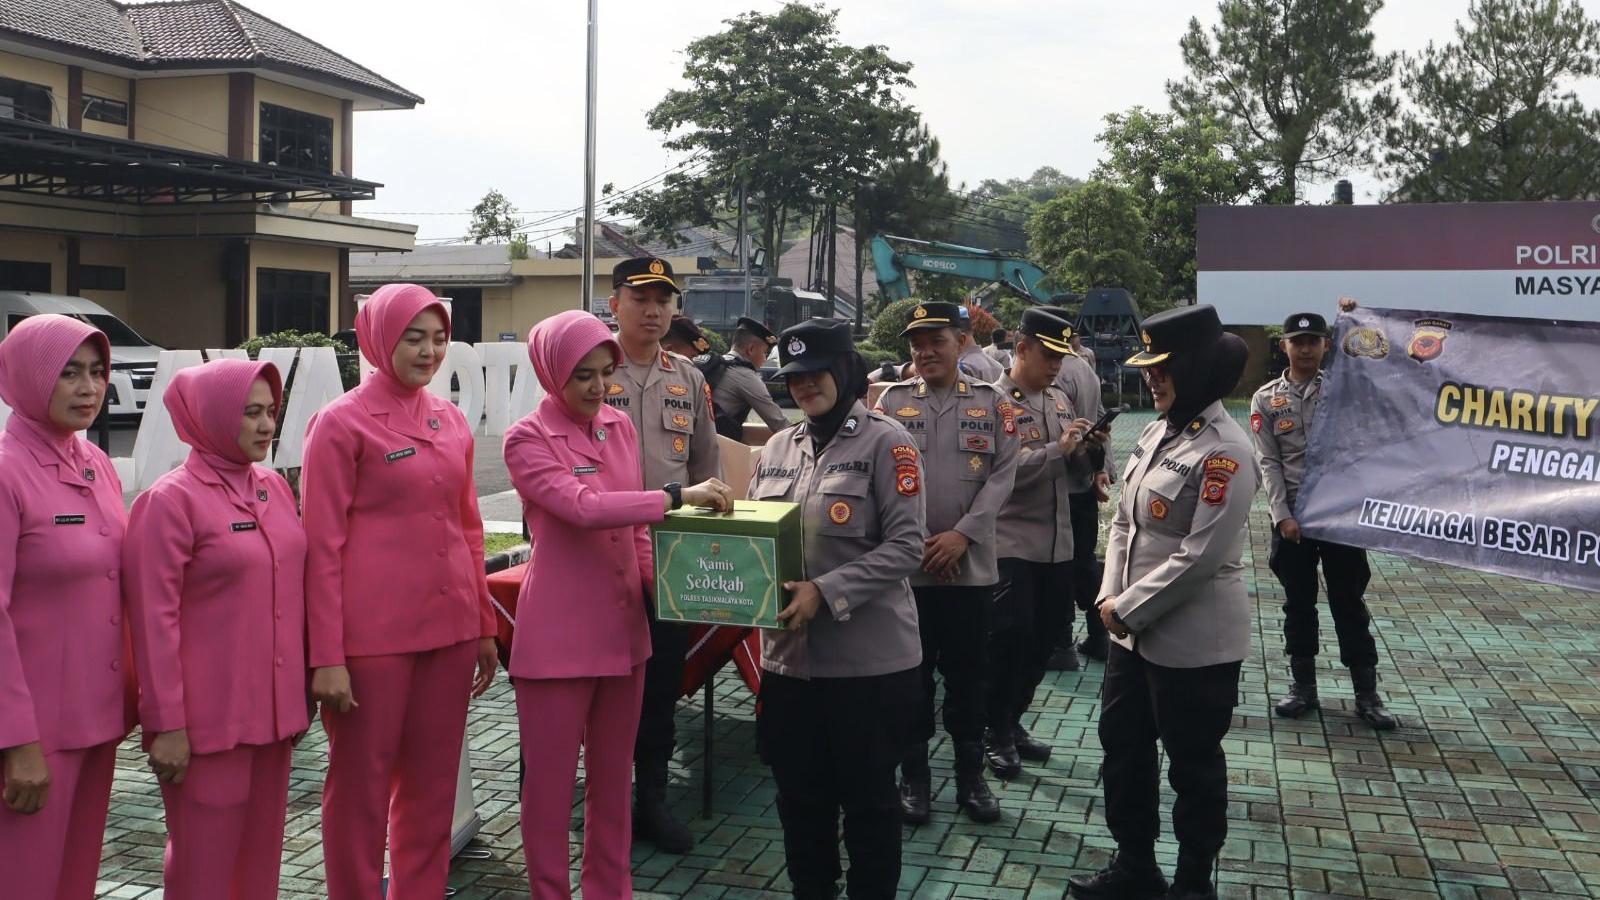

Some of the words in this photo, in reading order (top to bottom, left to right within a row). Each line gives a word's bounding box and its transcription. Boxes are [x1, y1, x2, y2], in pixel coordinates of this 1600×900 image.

[1516, 245, 1597, 264] POLRI
[664, 398, 692, 410] POLRI
[1437, 384, 1599, 438] CHARITY
[960, 421, 994, 431] POLRI
[827, 461, 870, 474] POLRI
[1160, 458, 1191, 477] POLRI
[1360, 500, 1475, 544] KELUARGA
[1484, 519, 1568, 560] BESAR
[697, 556, 735, 571] Kamis
[685, 574, 744, 594] Sedekah
[680, 594, 700, 602] POLRES
[738, 598, 754, 606] KOTA
